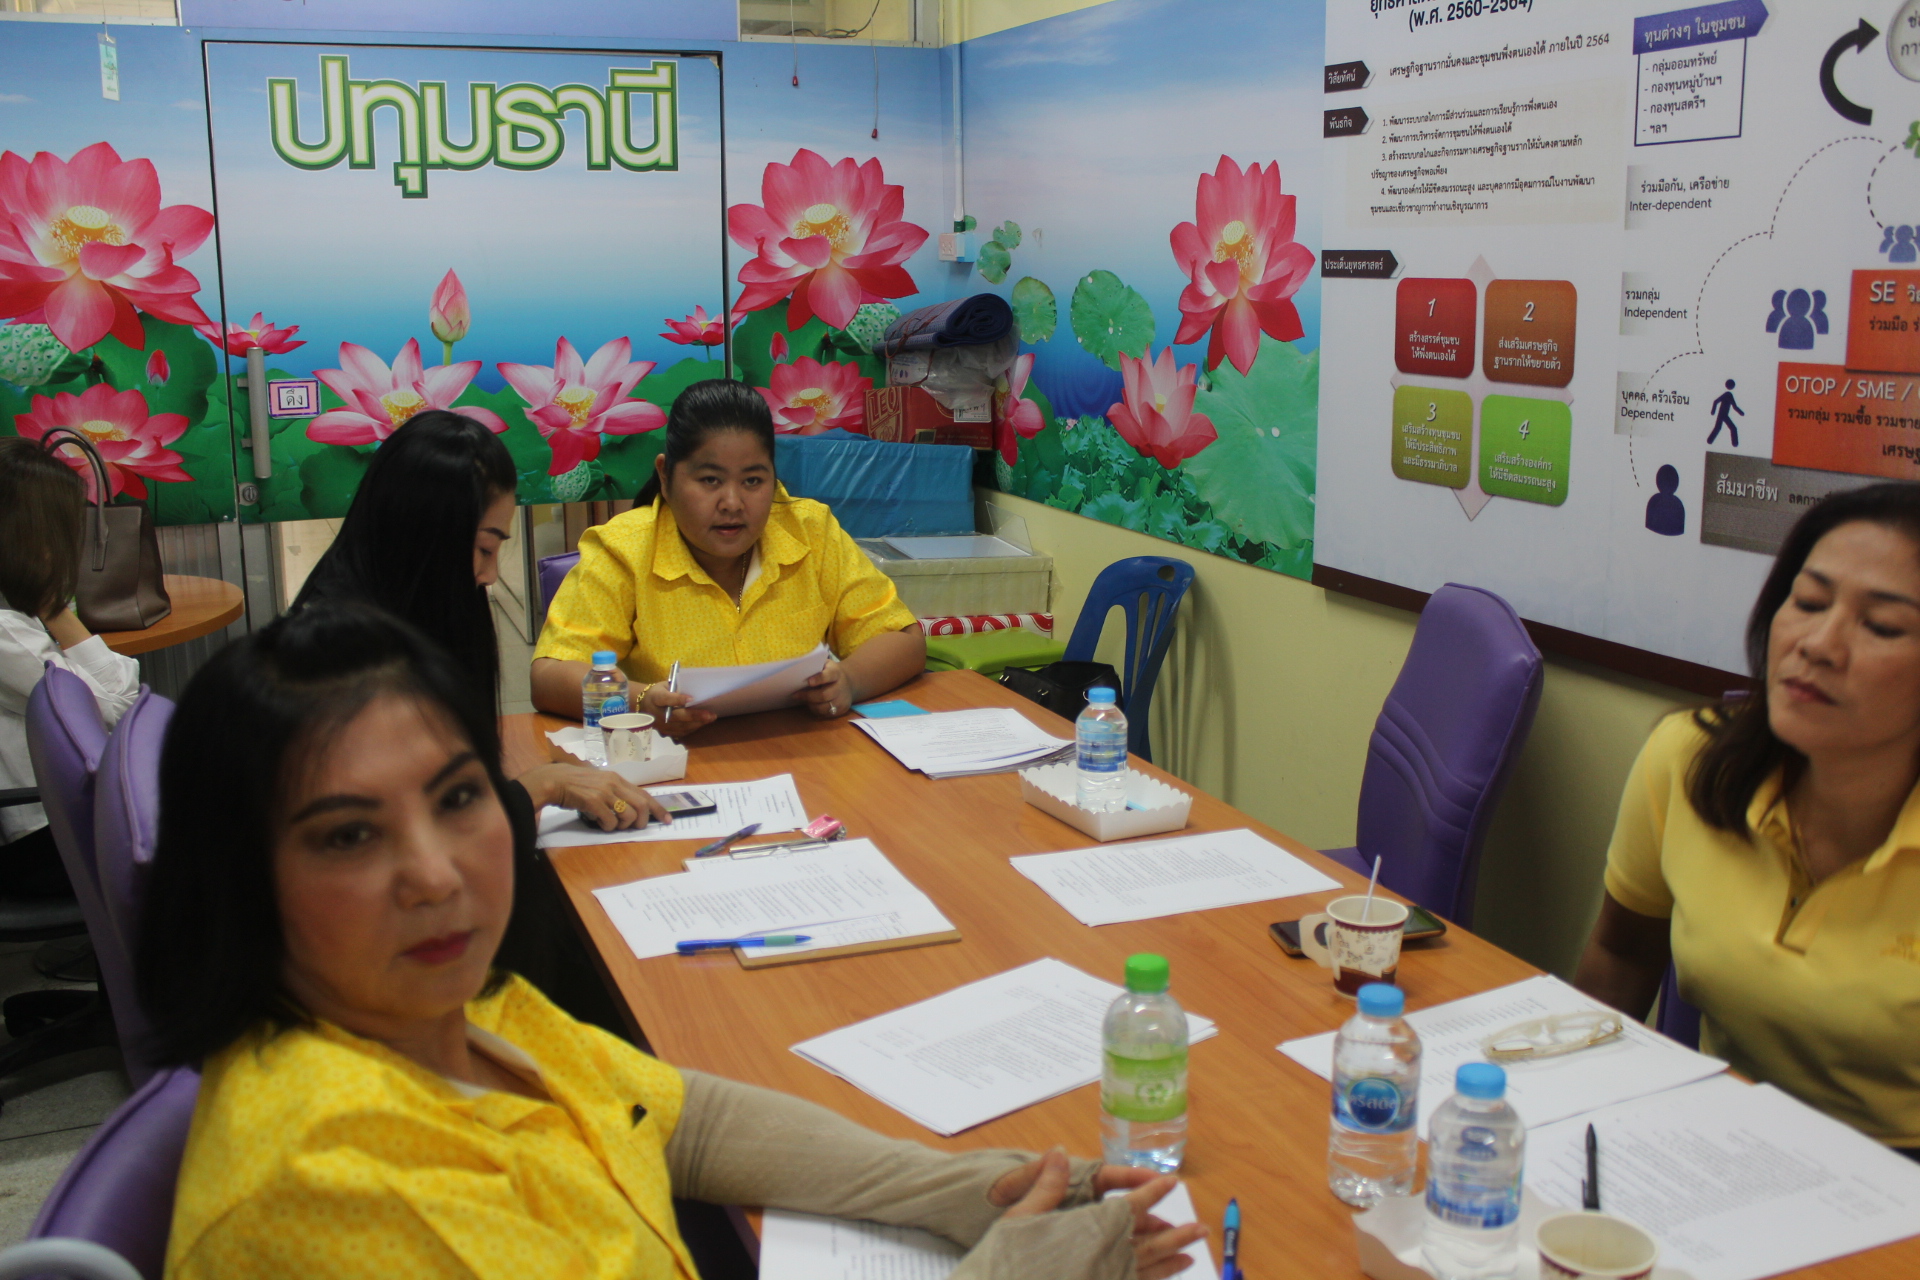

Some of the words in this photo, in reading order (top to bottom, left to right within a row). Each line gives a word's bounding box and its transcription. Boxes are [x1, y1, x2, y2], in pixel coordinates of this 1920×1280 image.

[1409, 7, 1443, 33] (พ.ศ.
[1645, 24, 1691, 48] ทุนต่างๆ
[1695, 16, 1746, 38] ในชุมชน
[1549, 34, 1583, 53] ภายในปี
[1586, 33, 1610, 48] 2564
[1652, 50, 1718, 76] กลุ่มออมทรัพย์
[1328, 68, 1357, 85] วิสัยทัศน์
[1651, 73, 1723, 95] กองทุนหมู่บ้านฯ
[1650, 95, 1706, 116] กองทุนสตรีฯ
[267, 54, 679, 199] ปทุมธานี
[1329, 115, 1353, 129] พันธกิจ
[1649, 123, 1668, 134] ฯลฯ
[1641, 178, 1686, 194] ร่วมมือกัน,
[1689, 175, 1730, 191] เครือข่าย
[1629, 198, 1712, 212] Inter-dependent
[1325, 256, 1384, 273] ประเด็นยุทธศาสตร์
[1625, 287, 1660, 304] รวมกลุ่ม
[1869, 281, 1897, 303] SE
[1428, 298, 1437, 317] 1
[1523, 301, 1535, 321] 2
[1624, 307, 1688, 320] Independent
[1869, 315, 1908, 332] ร่วมมือ
[1412, 346, 1456, 361] ให้พึ่งตนเองได้
[1498, 336, 1558, 355] ส่งเสริมเศรษฐกิจ
[1494, 354, 1561, 370] ฐานรากให้ขยายตัว
[286, 388, 303, 406] ดึง
[1785, 375, 1836, 395] OTOP
[1856, 380, 1896, 400] SME
[1622, 390, 1649, 404] บุคคล,
[1652, 389, 1690, 406] ครัวเรือน
[1426, 402, 1437, 422] 3
[1621, 406, 1675, 421] Dependent
[1788, 407, 1830, 426] รวมกลุ่ม
[1518, 419, 1530, 440] 4
[1716, 473, 1779, 502] สัมมาชีพ
